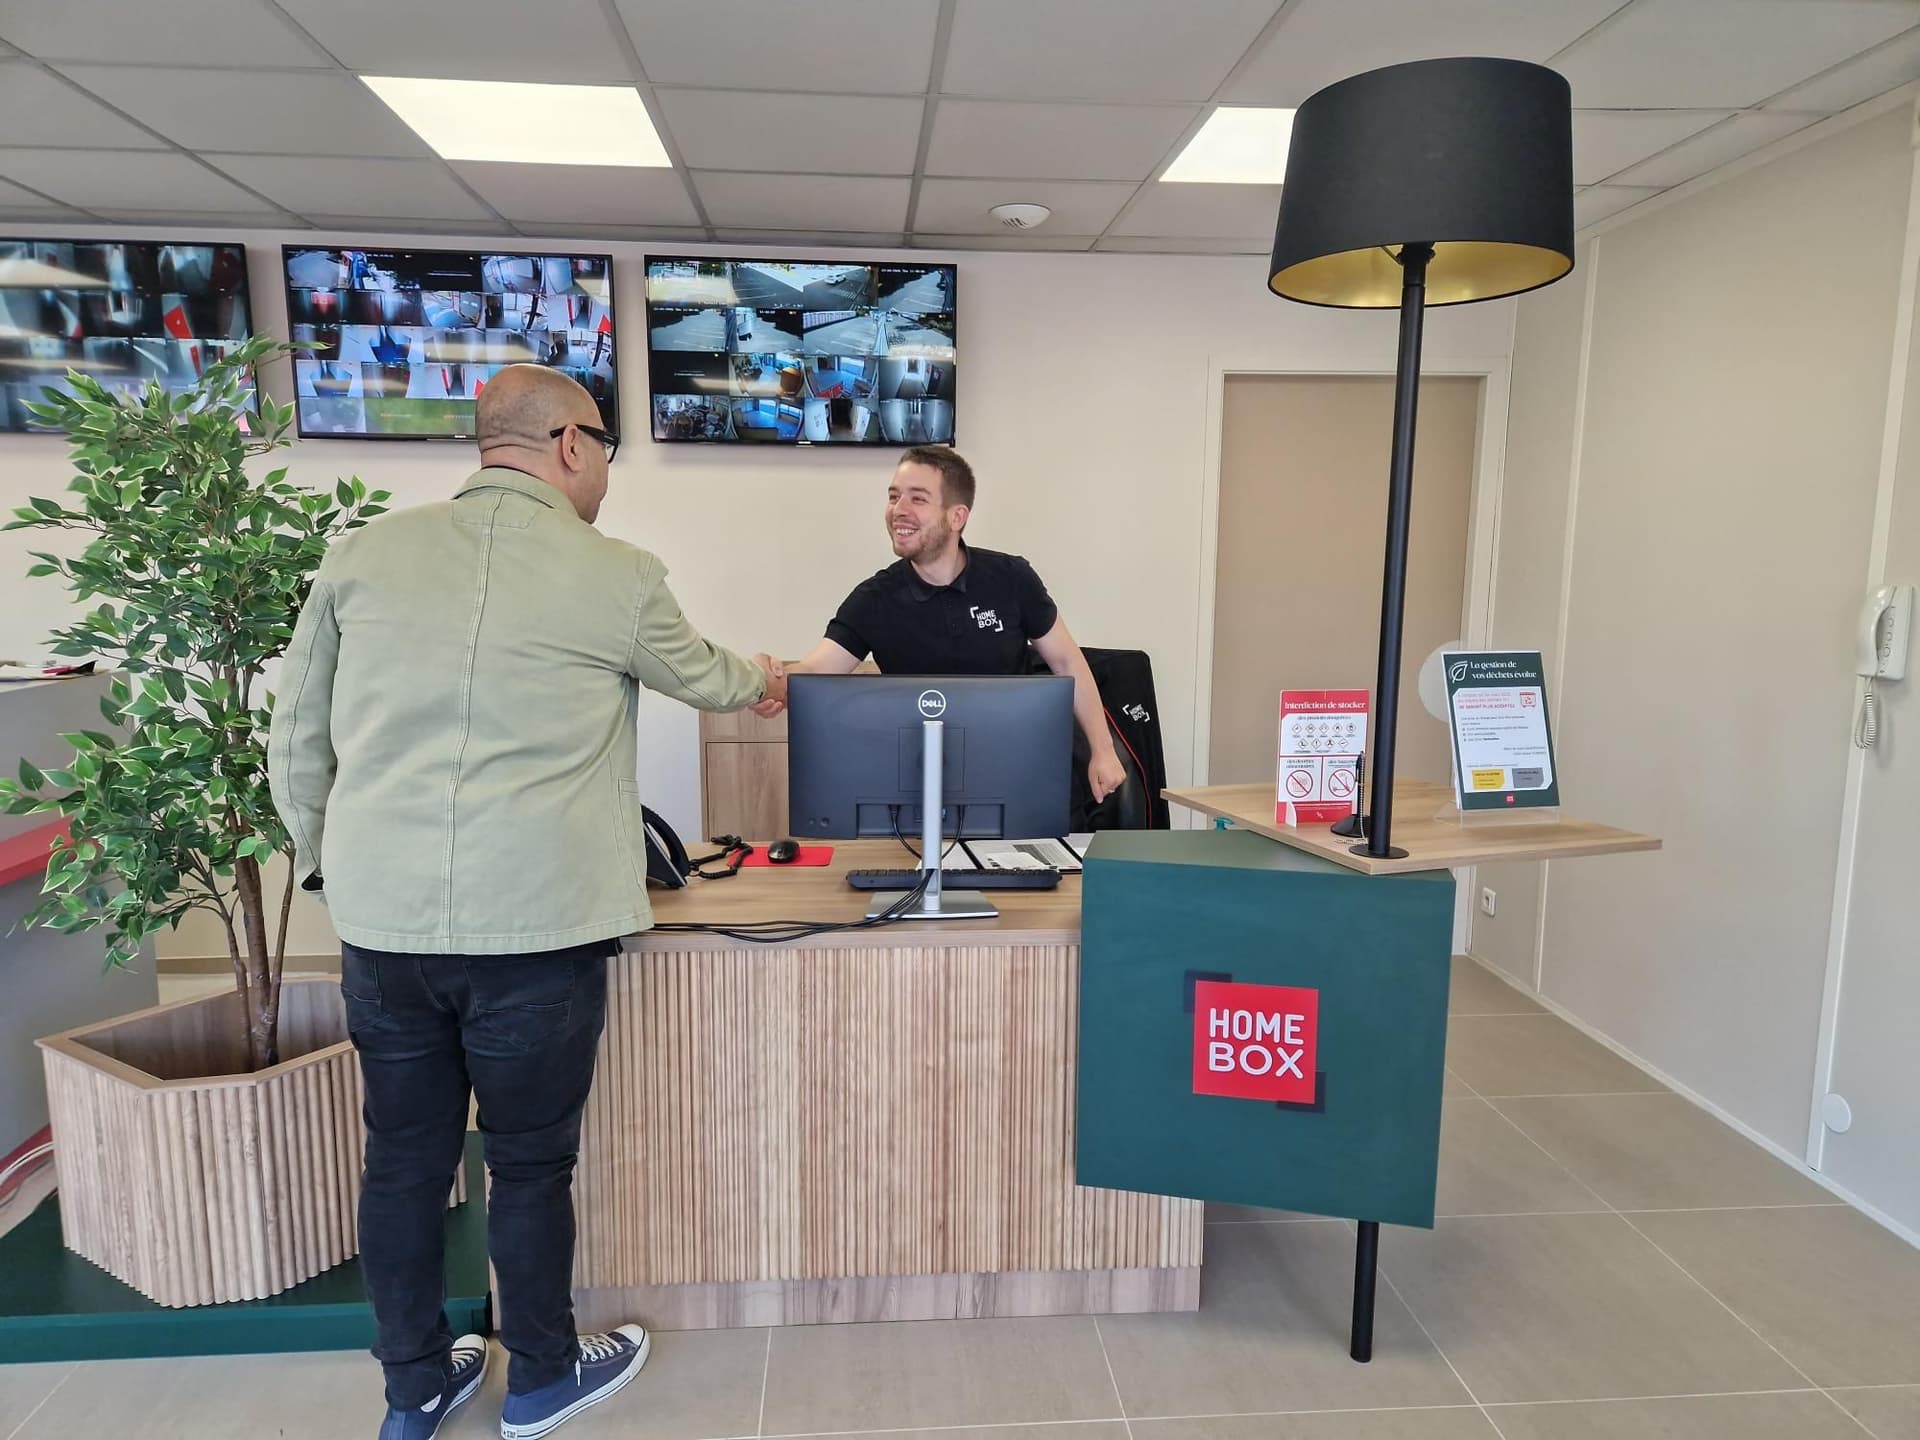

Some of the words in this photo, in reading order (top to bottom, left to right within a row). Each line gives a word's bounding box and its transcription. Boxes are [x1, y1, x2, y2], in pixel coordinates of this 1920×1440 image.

[978, 617, 998, 628] BOX
[1470, 661, 1480, 669] La
[1481, 661, 1507, 671] gestion
[1486, 671, 1513, 679] déchets
[1210, 1008, 1304, 1045] HOME
[1209, 1041, 1303, 1079] BOX
